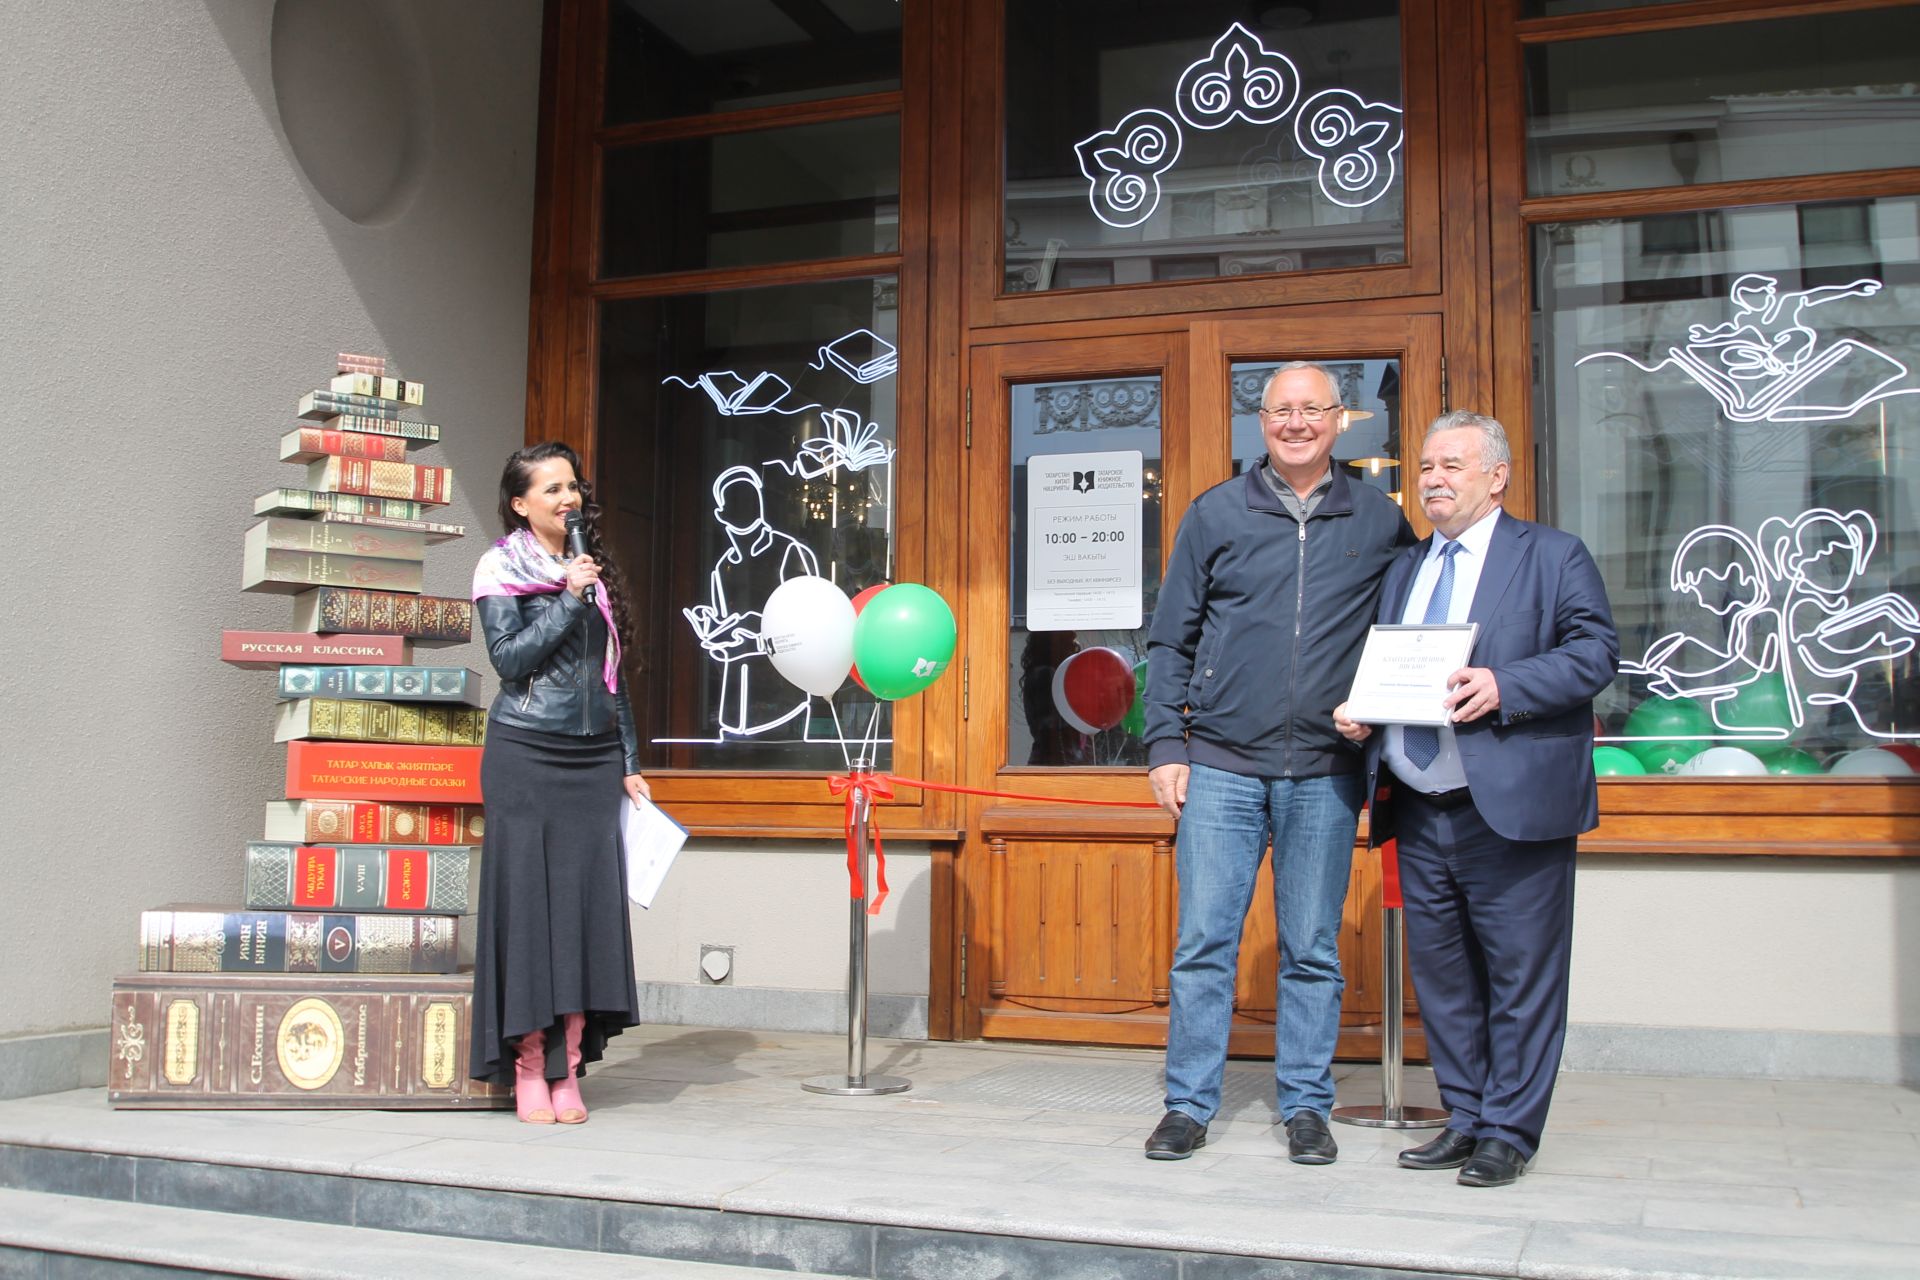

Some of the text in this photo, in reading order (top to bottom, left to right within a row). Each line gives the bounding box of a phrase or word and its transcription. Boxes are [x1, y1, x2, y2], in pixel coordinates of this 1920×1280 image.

[1097, 482, 1135, 490] ИЗДАТЕЛЬСТВО
[1052, 513, 1117, 524] РЕЖИМ РАБОТЫ
[1045, 533, 1077, 544] 10:00
[1092, 530, 1124, 543] 20:00
[1078, 553, 1107, 561] ВАКЫТЫ
[241, 643, 384, 656] РУССКАЯ КЛАССИКА
[327, 760, 359, 769] ТАТАР
[360, 761, 394, 770] ХАЛЫК
[311, 775, 466, 787] ТАТАРСКИЕ НАРОДНЫЕ СКАЗКИ
[307, 856, 316, 899] ГАБДУЛЛА
[356, 864, 366, 893] V-VIII
[239, 924, 252, 961] ИВАН
[255, 920, 268, 965] БУНИН
[334, 938, 347, 951] V
[250, 1005, 264, 1084] С.Есенин
[354, 1004, 368, 1086] Избранное
